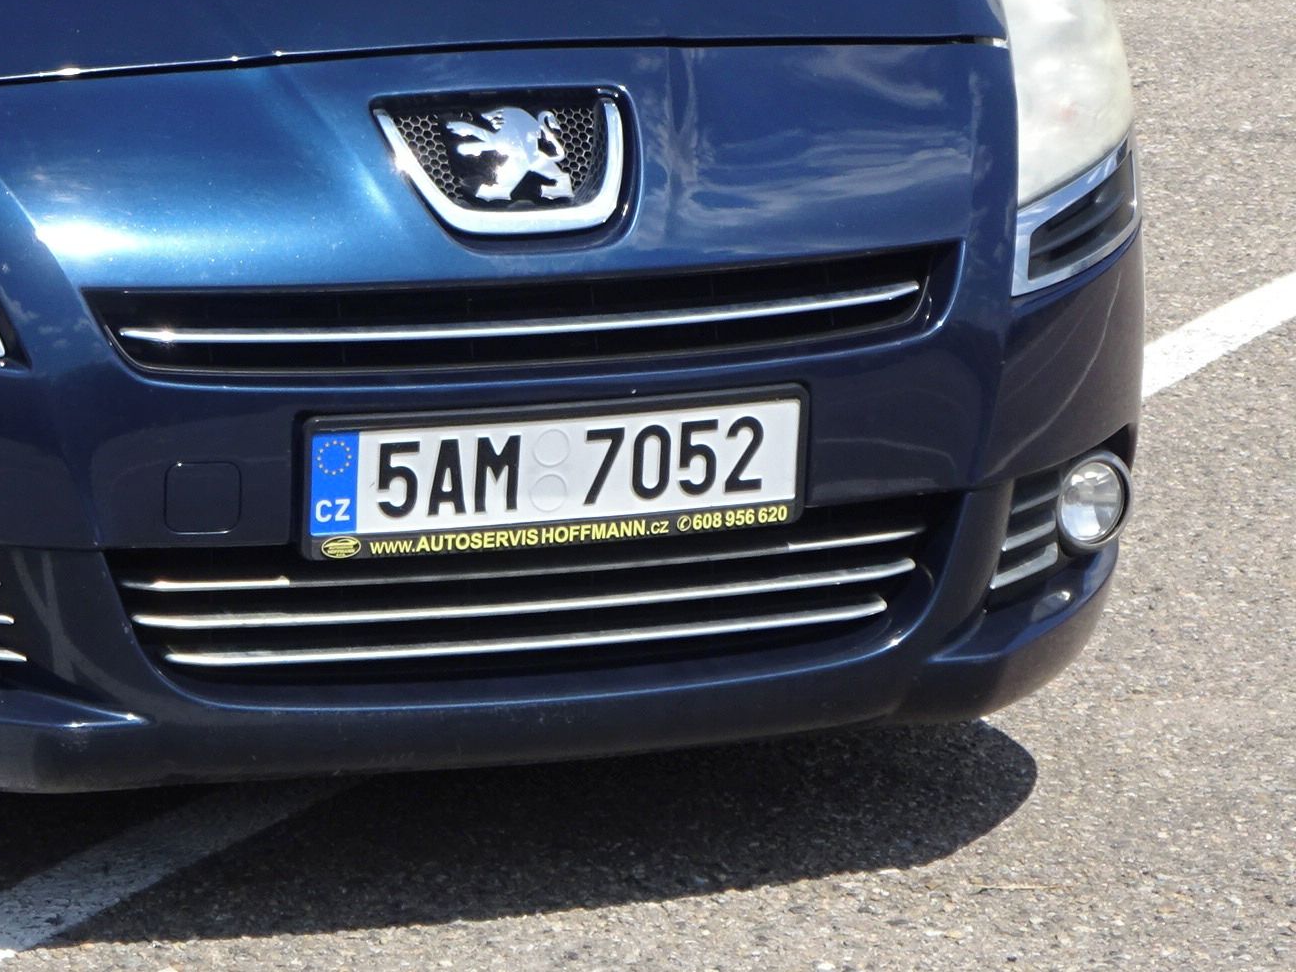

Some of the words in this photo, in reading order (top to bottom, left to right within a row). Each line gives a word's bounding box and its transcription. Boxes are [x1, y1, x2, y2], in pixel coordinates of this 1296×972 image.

[377, 434, 522, 519] 5AM
[584, 415, 764, 506] 7052
[315, 499, 351, 523] CZ
[692, 512, 723, 530] 608
[725, 508, 756, 527] 956
[757, 505, 788, 524] 620
